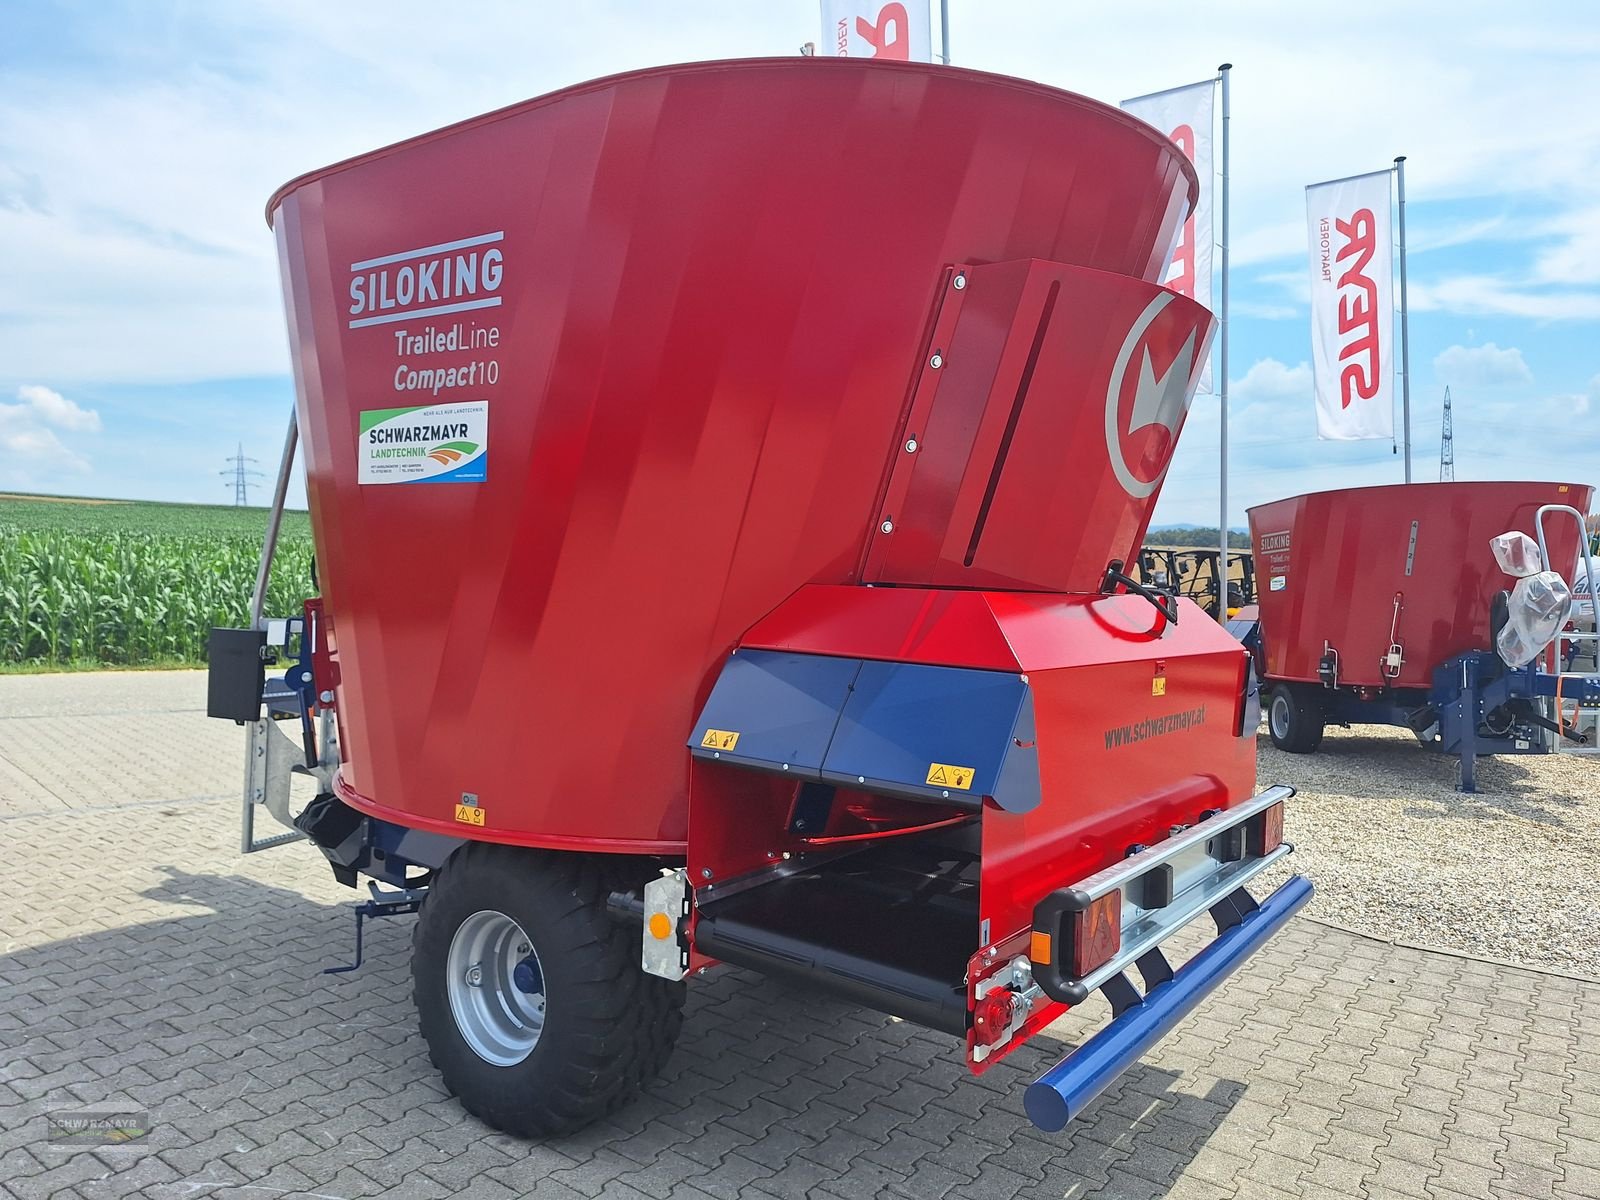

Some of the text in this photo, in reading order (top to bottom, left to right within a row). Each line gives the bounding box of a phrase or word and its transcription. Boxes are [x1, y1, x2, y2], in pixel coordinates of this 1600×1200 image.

[349, 248, 504, 315] SILOKING
[395, 321, 500, 356] TrailedLine
[394, 361, 499, 396] Compact10
[369, 423, 468, 444] SCHWARZMAYR
[371, 447, 427, 459] LANDTECHNIK
[1261, 535, 1290, 550] SILOKING
[1104, 704, 1206, 750] www.schwarzmayr.at
